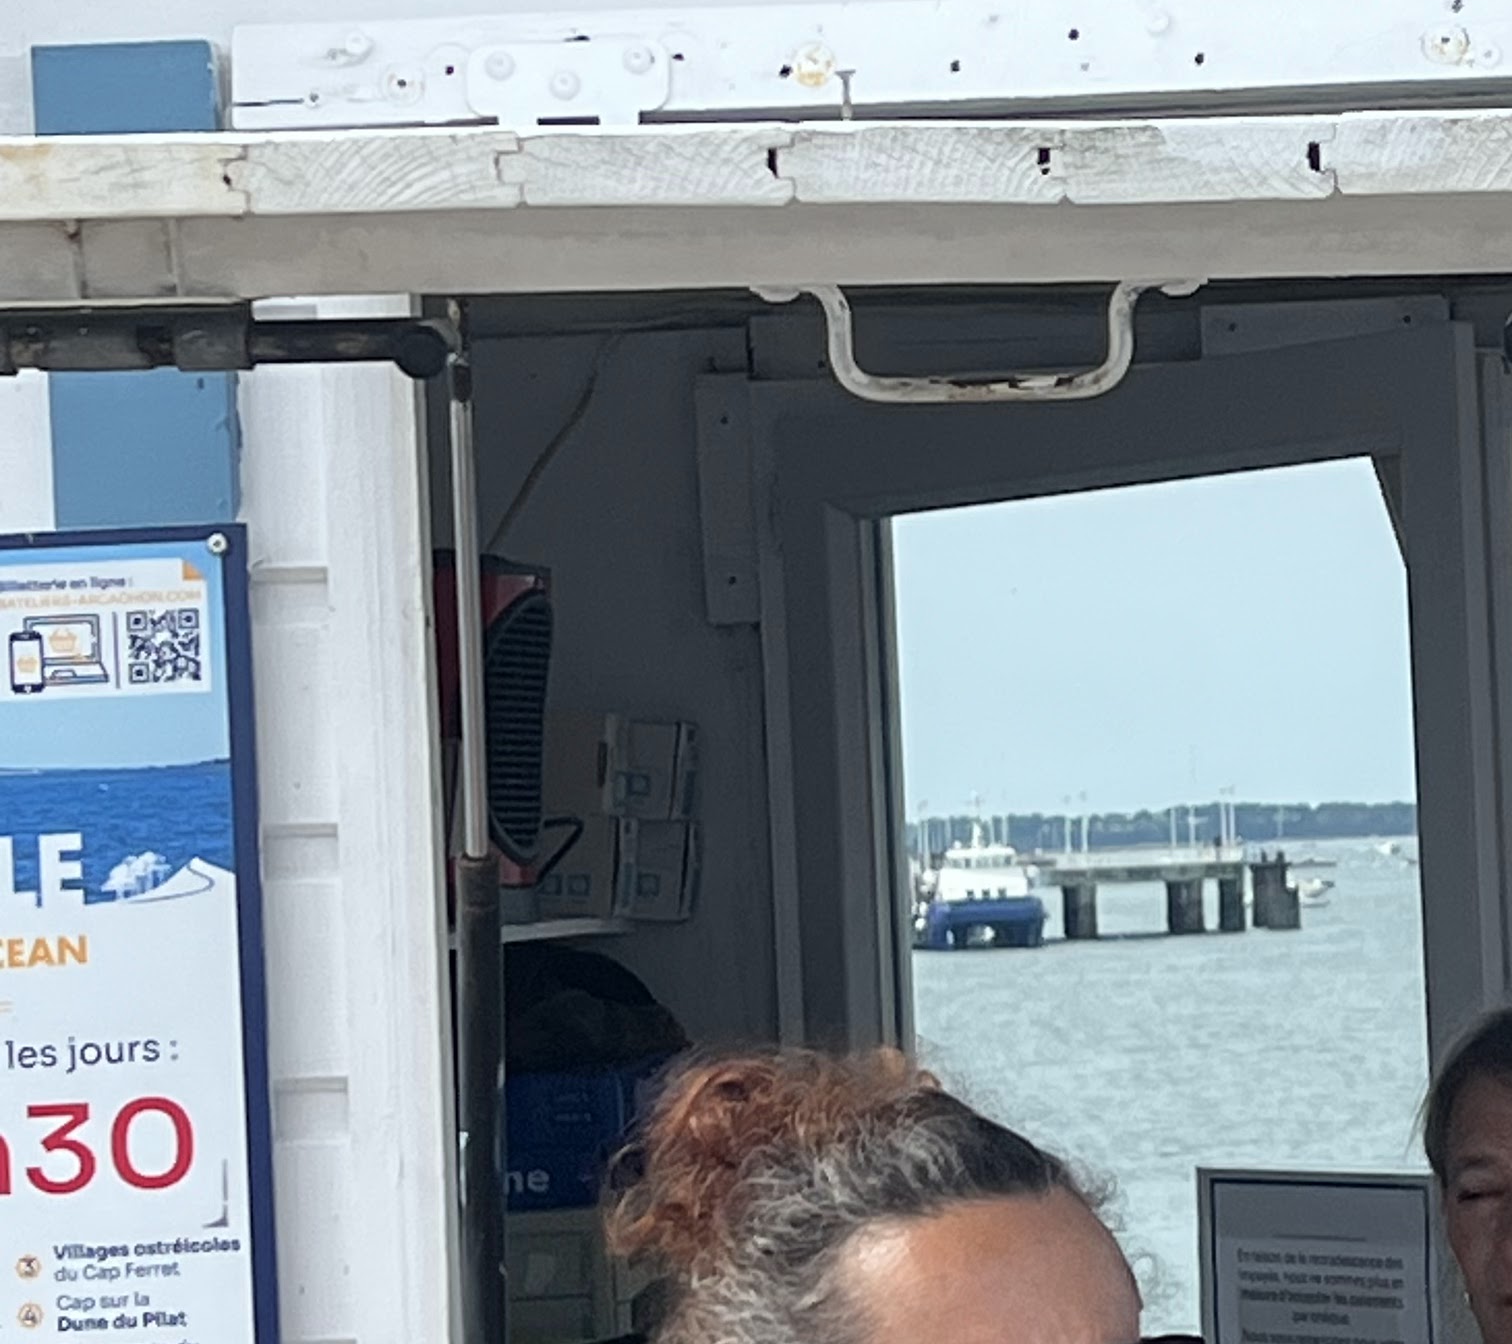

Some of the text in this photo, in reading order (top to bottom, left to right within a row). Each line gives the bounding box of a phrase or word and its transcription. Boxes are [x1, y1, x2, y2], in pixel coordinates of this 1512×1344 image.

[0, 934, 88, 969] EAN
[5, 1040, 57, 1069] les
[66, 1036, 161, 1074] jours
[0, 1096, 194, 1195] 30
[53, 1244, 129, 1262] Villages
[134, 1237, 240, 1256] ostréicoles
[54, 1262, 180, 1283] du Cap Ferret
[56, 1295, 95, 1312] Cap
[100, 1295, 129, 1309] sur
[134, 1292, 151, 1307] la
[57, 1311, 188, 1333] Dune du Pilat
